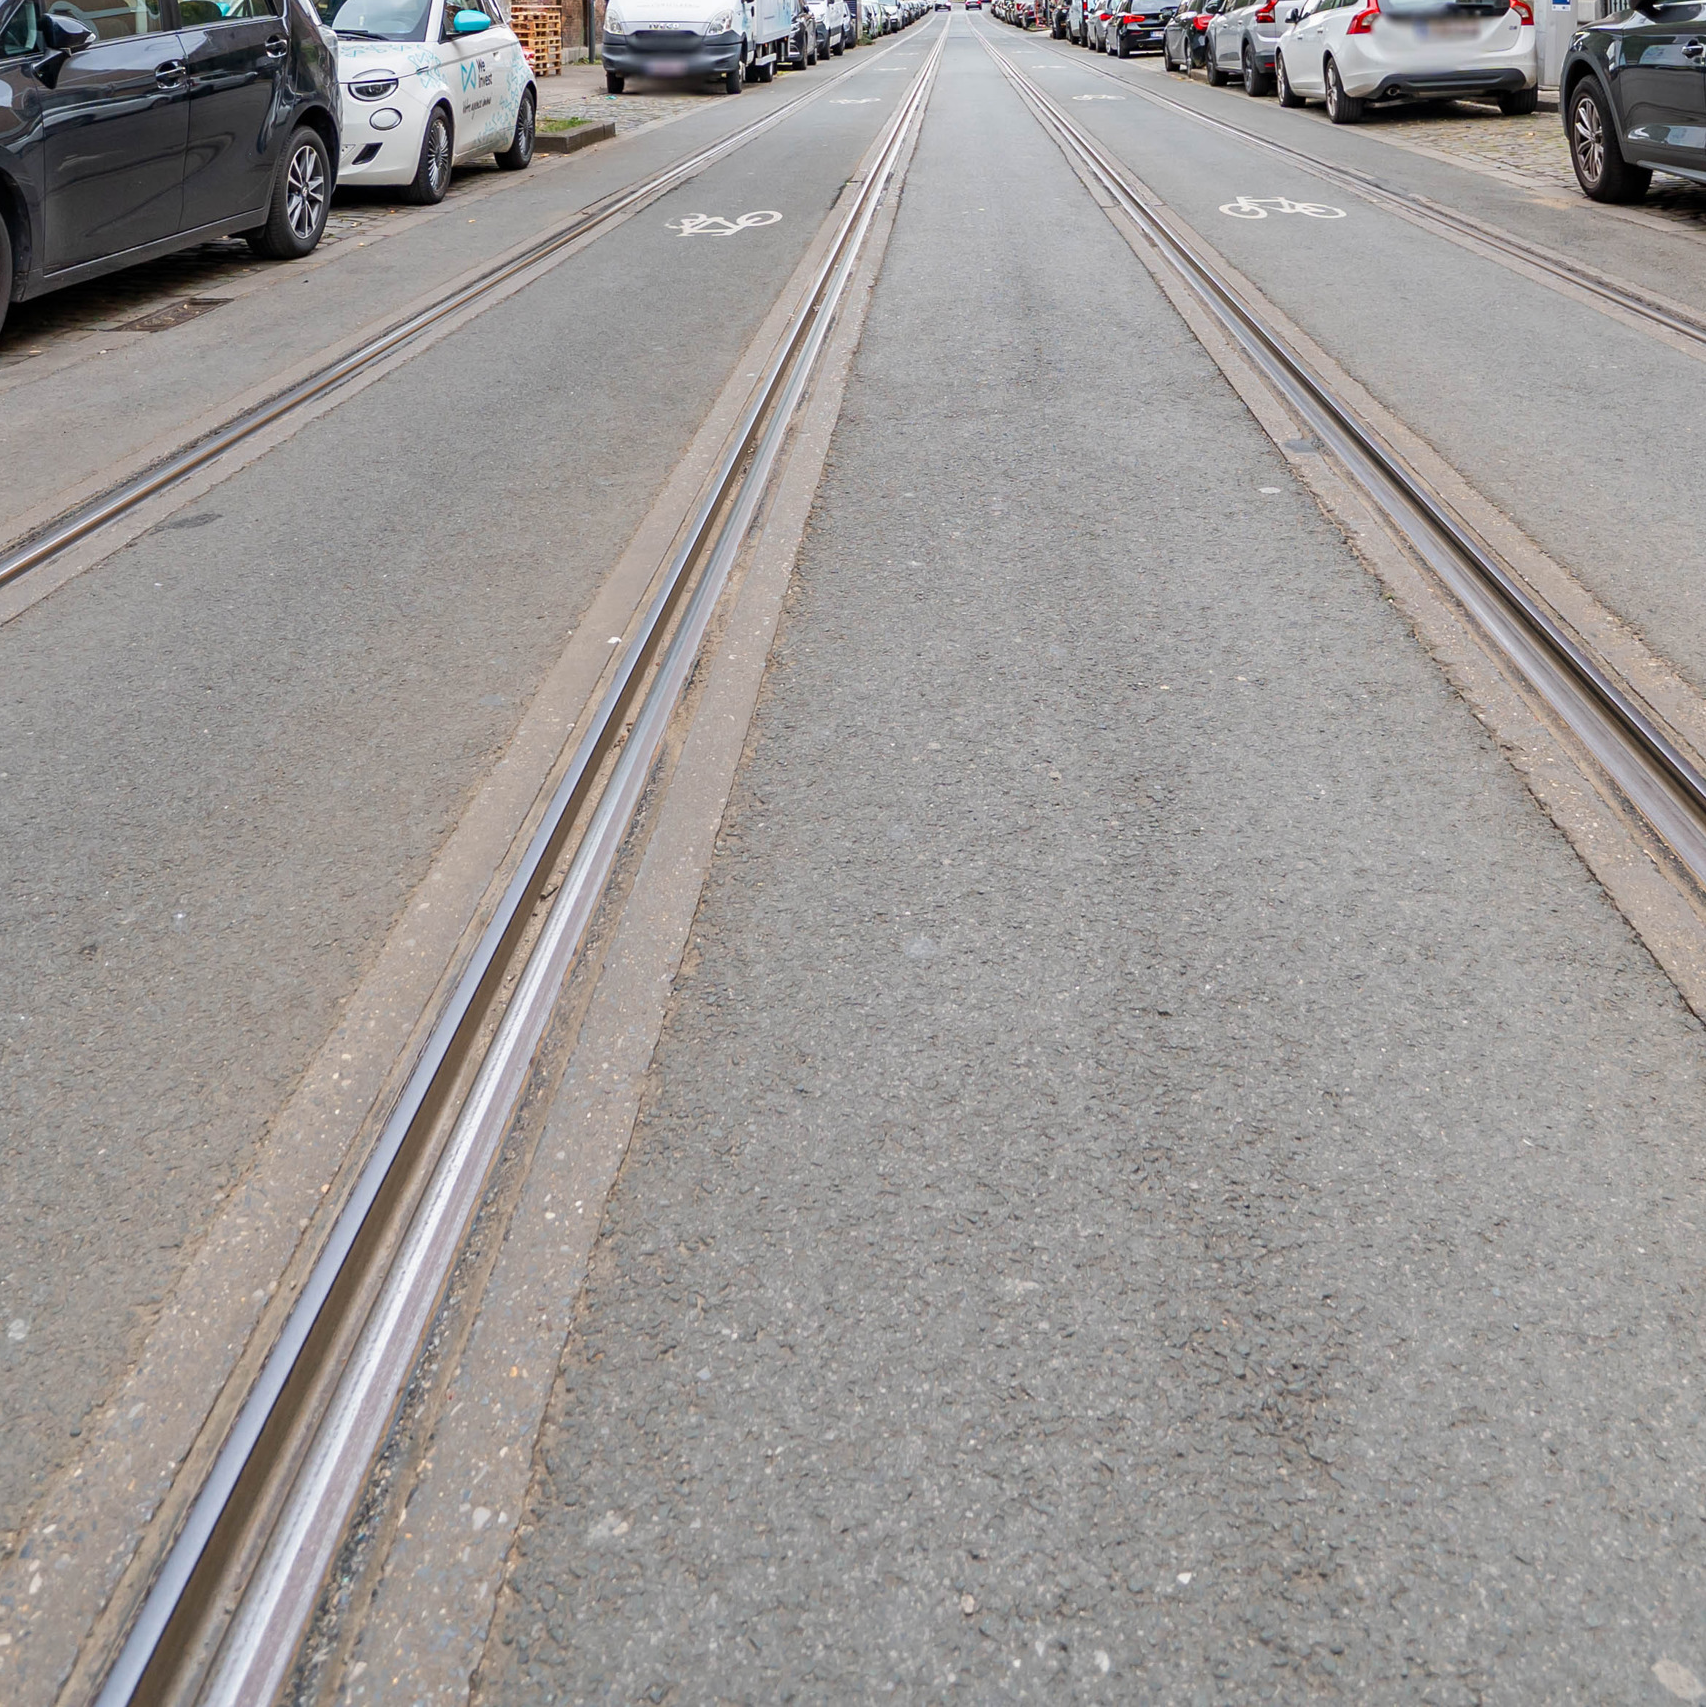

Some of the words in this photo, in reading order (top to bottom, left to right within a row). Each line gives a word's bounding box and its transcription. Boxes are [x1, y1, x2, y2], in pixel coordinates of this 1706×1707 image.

[649, 22, 680, 30] IVECO
[476, 58, 486, 73] We
[478, 73, 493, 88] Invest
